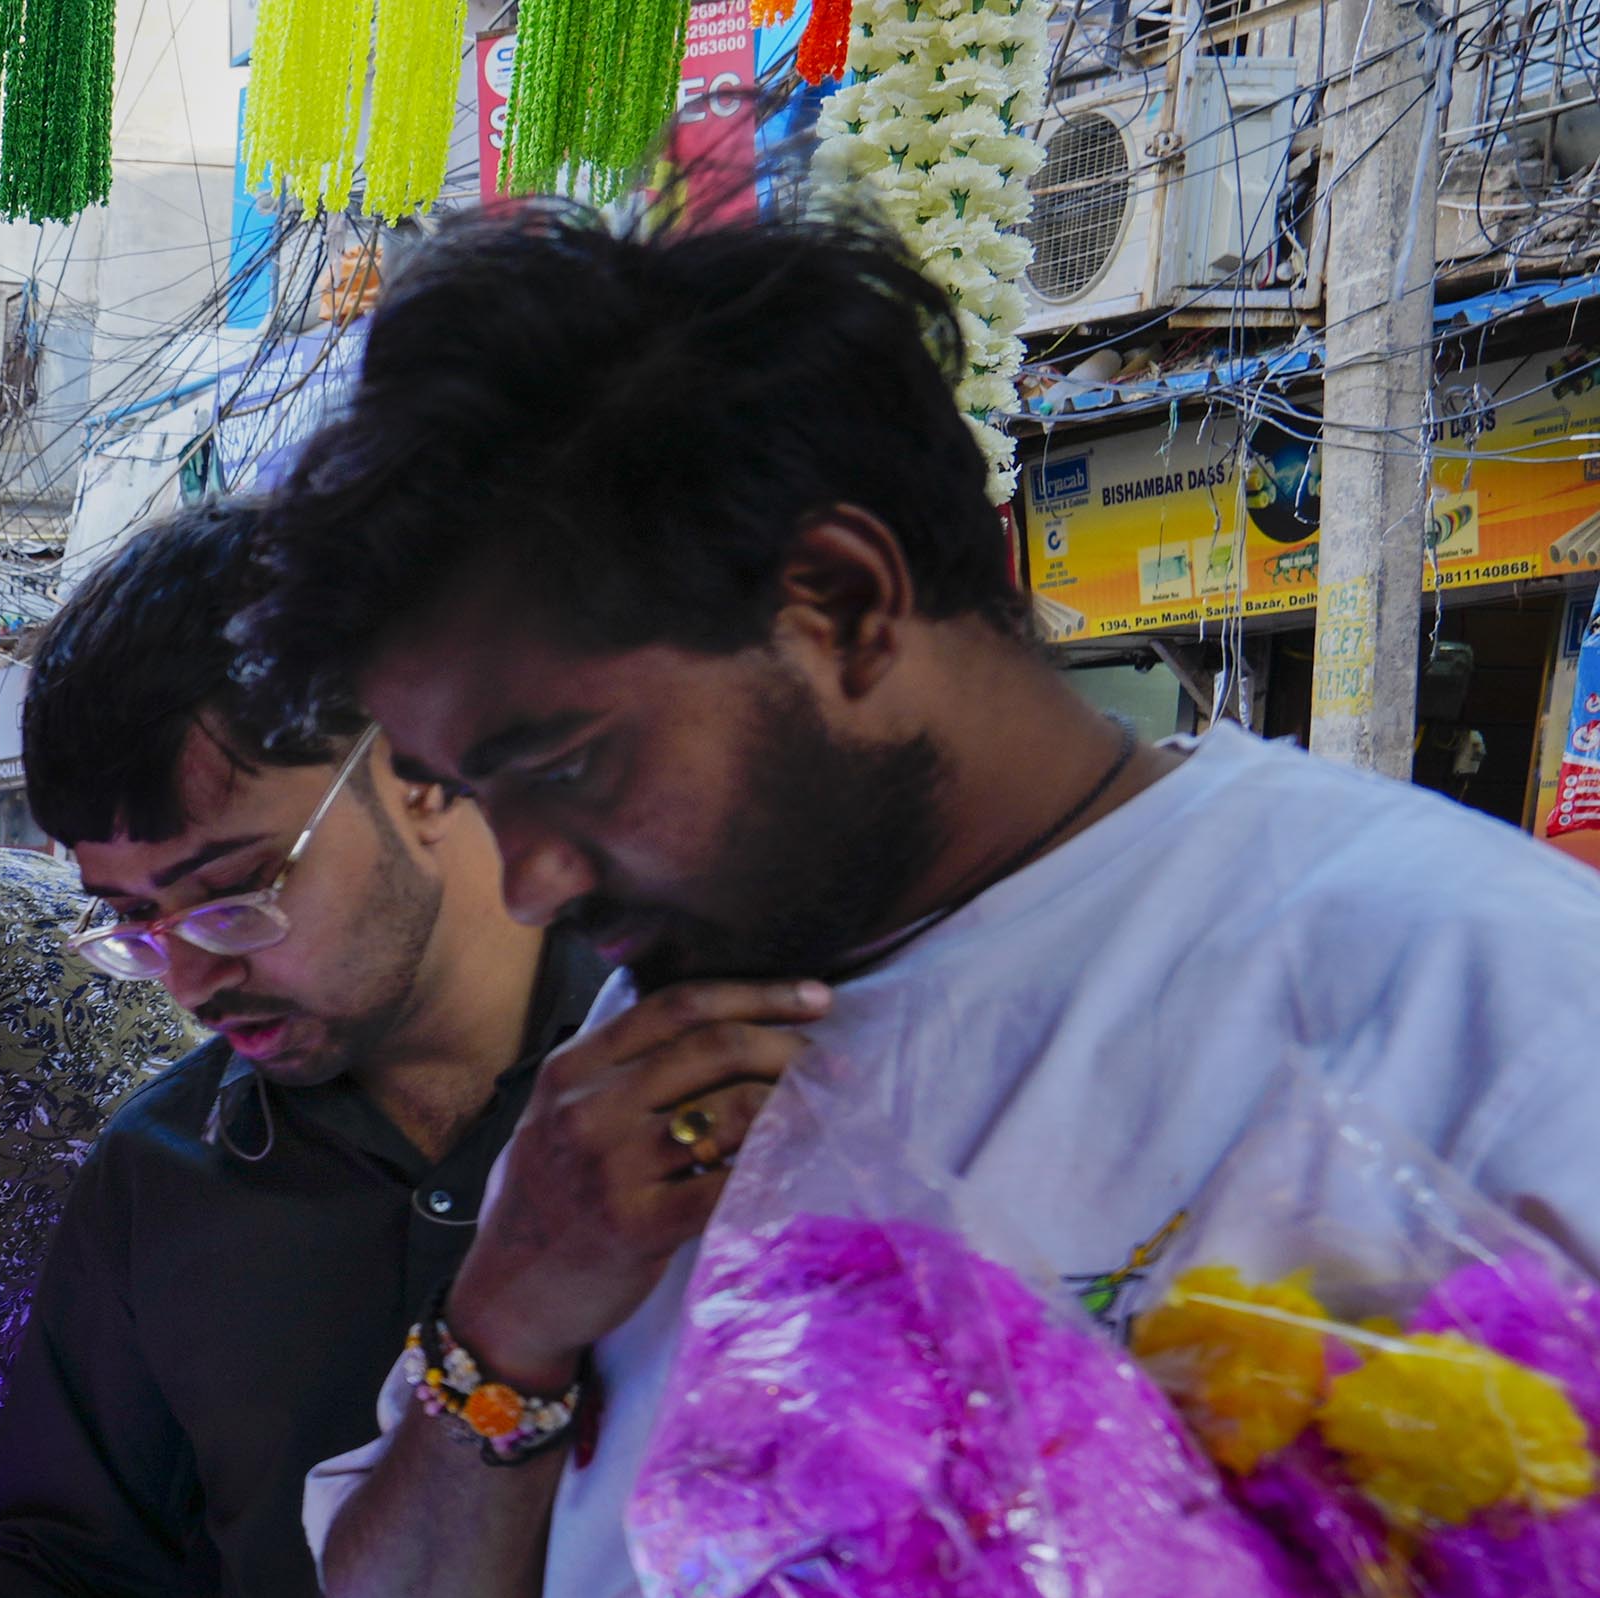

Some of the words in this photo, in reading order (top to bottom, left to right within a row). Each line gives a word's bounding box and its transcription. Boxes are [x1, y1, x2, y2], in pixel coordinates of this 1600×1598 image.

[1102, 472, 1184, 507] BISHAMBAR
[1188, 464, 1226, 491] DASS
[1435, 561, 1530, 586] 9811140868
[1100, 619, 1132, 632] 1394,
[1135, 615, 1159, 627] Pan
[1162, 609, 1202, 624] Mandi,
[1245, 597, 1286, 612] Bazar,
[1289, 594, 1318, 607] Delh
